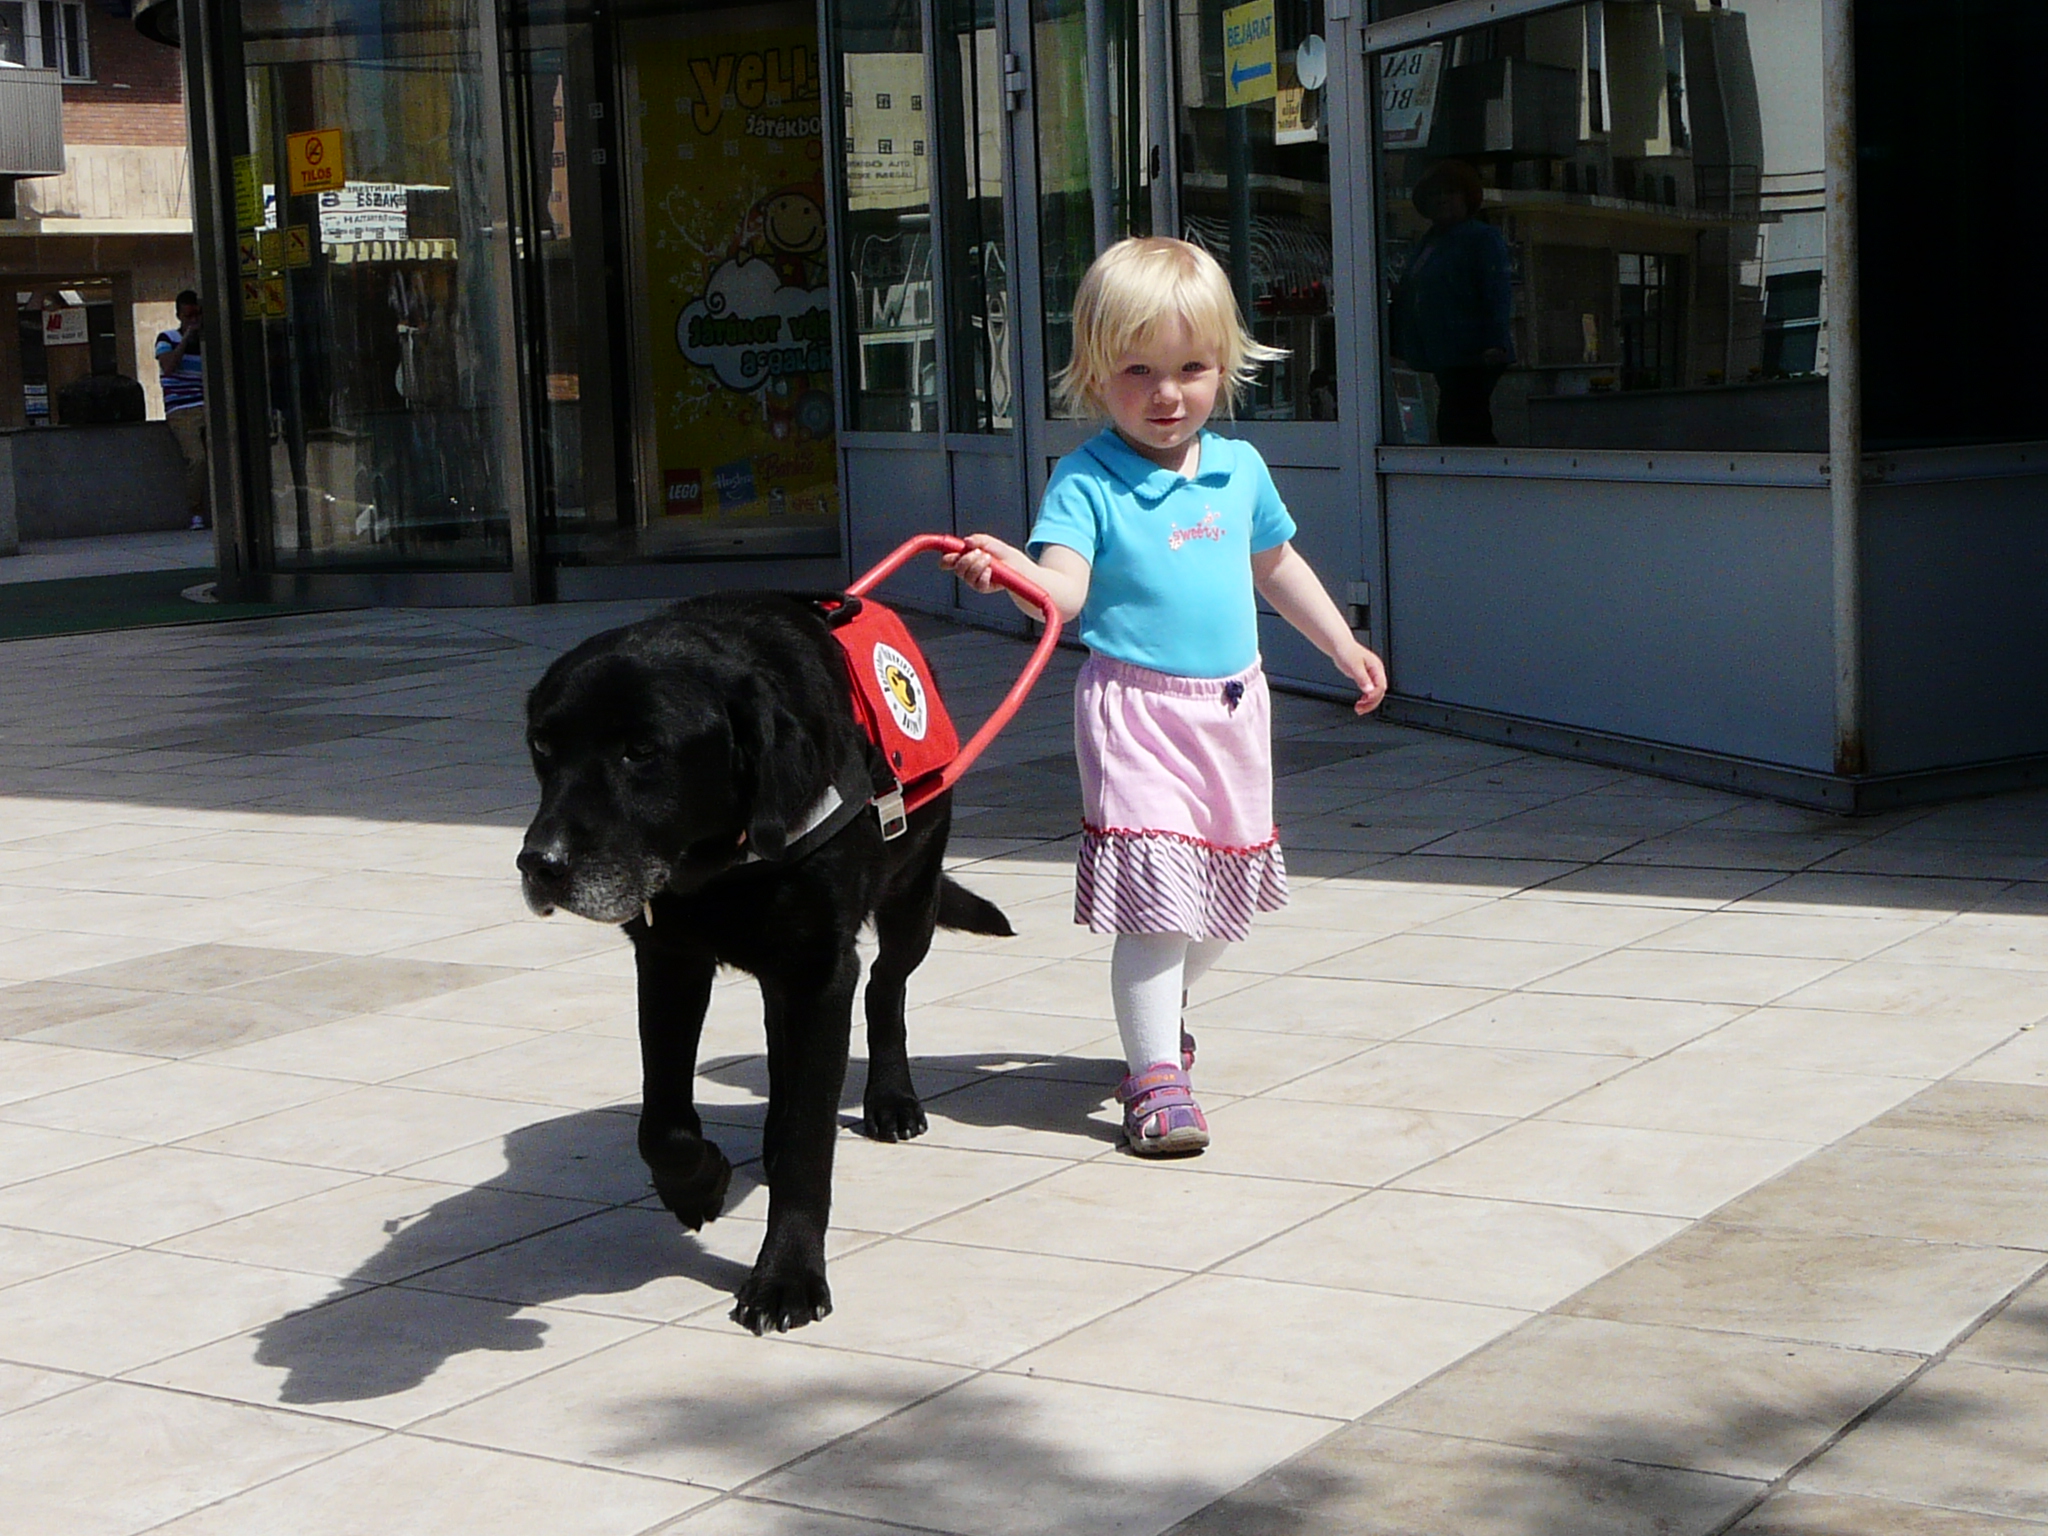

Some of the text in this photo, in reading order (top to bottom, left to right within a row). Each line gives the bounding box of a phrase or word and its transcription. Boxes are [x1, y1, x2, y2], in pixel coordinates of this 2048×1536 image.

[1226, 13, 1273, 47] BEJÁRAT
[302, 167, 332, 182] TILOS
[668, 483, 700, 500] LEGO
[1171, 526, 1220, 543] sweety
